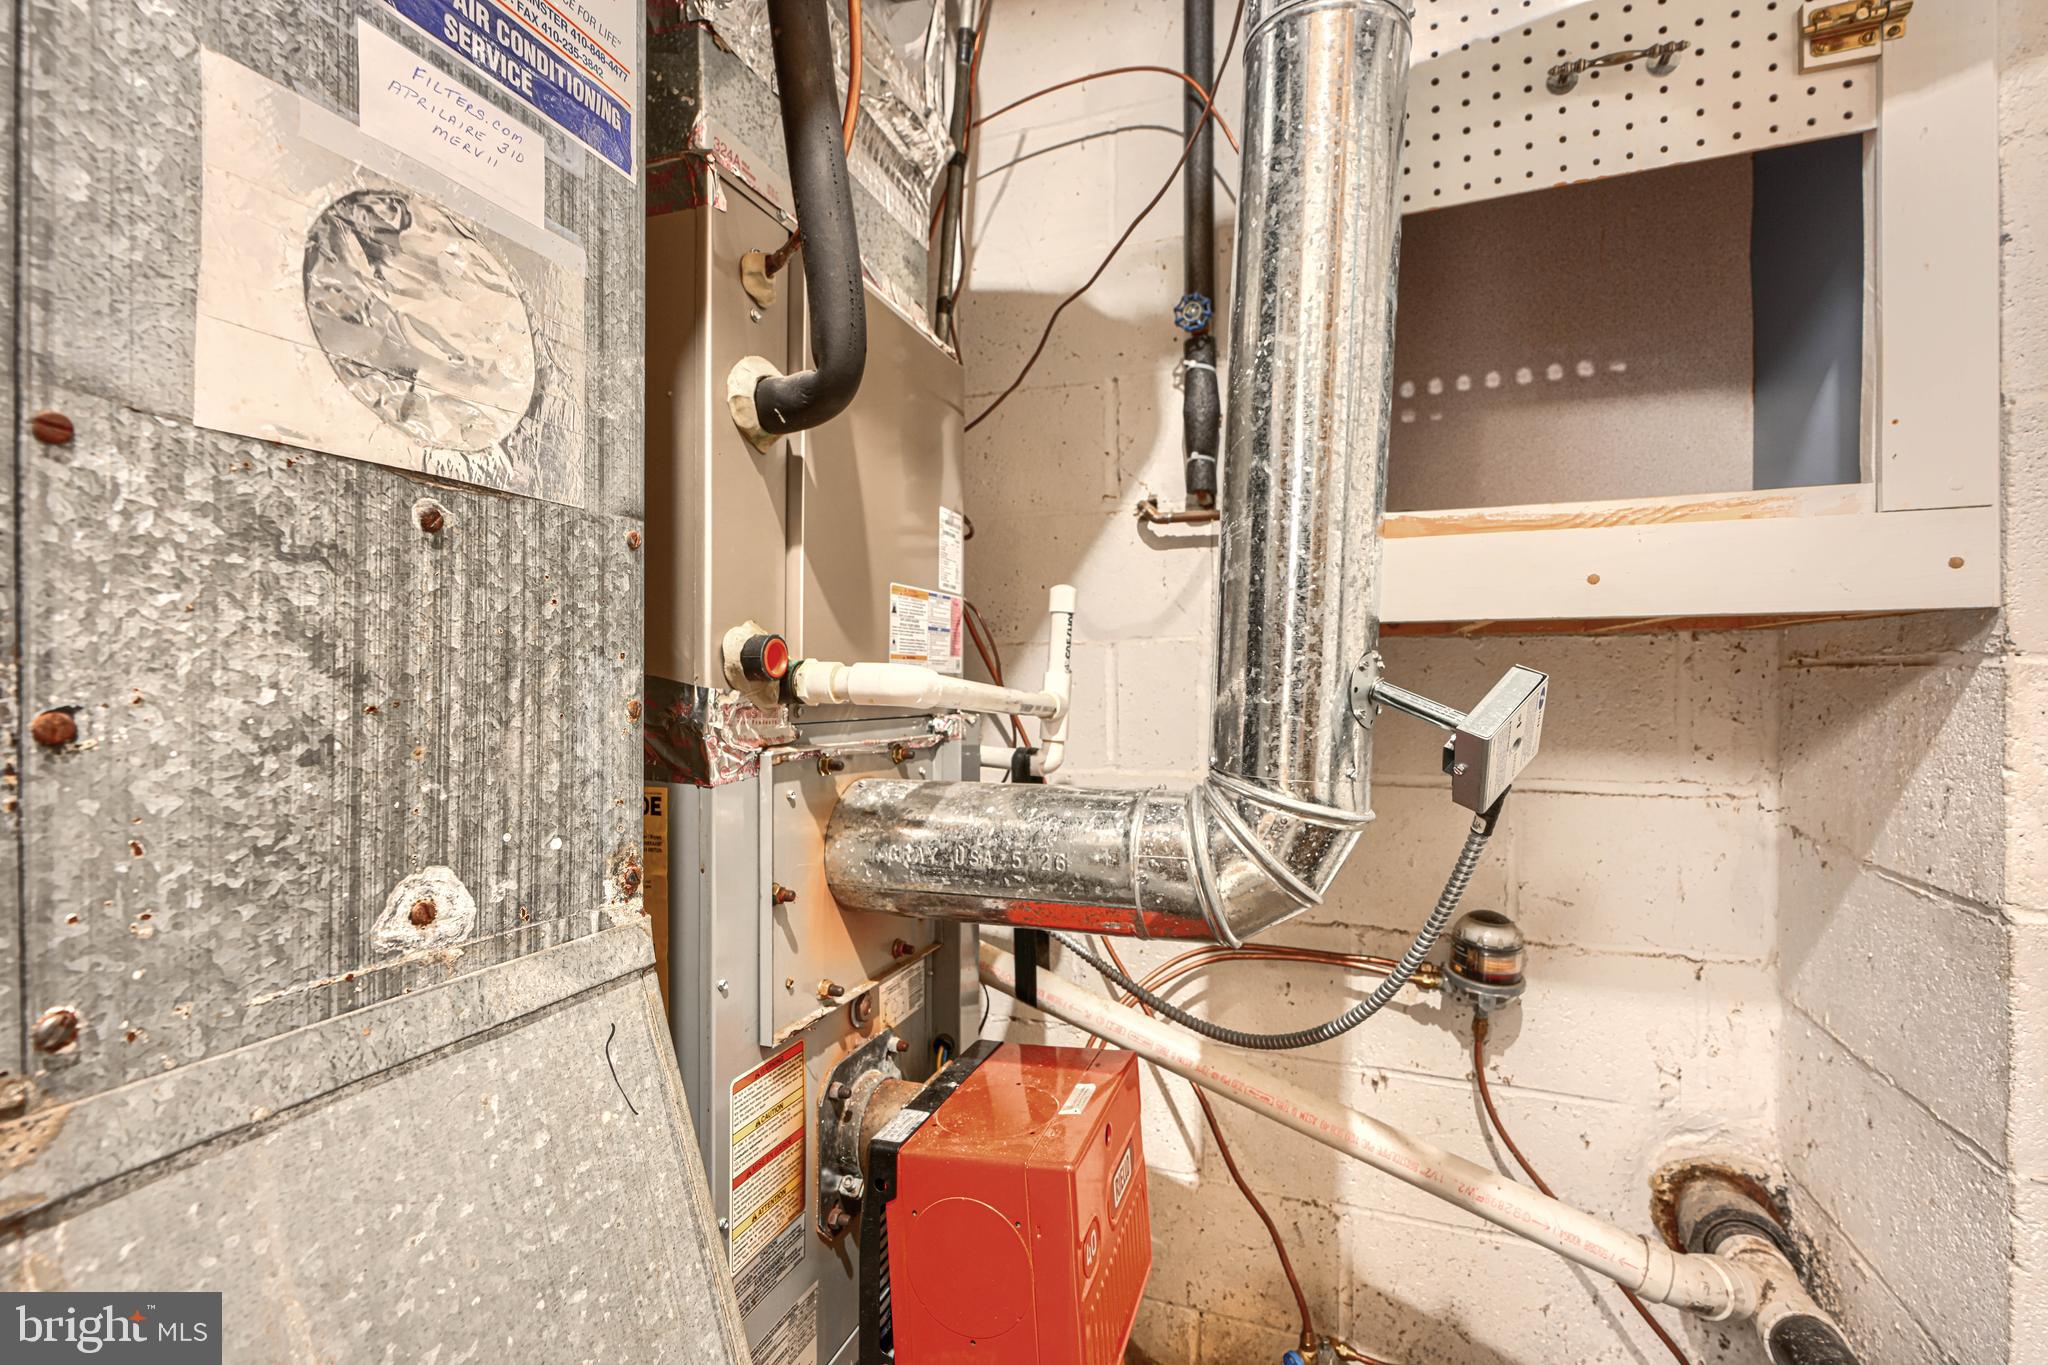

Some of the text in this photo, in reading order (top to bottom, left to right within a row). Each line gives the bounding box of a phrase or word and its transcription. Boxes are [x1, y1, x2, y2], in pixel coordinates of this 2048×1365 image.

[577, 4, 597, 30] FOR
[443, 12, 534, 98] SERVICE
[516, 0, 604, 80] FAX 410-235-3842
[570, 28, 628, 82] 410-848-4477
[452, 0, 622, 132] AIR CONDITIONING
[387, 79, 525, 165] APRILAIRE 310
[431, 124, 481, 161] MERV
[956, 845, 994, 869] USA
[1041, 853, 1067, 873] 26
[758, 1187, 787, 1215] ATTENTION
[1086, 1229, 1097, 1266] 40
